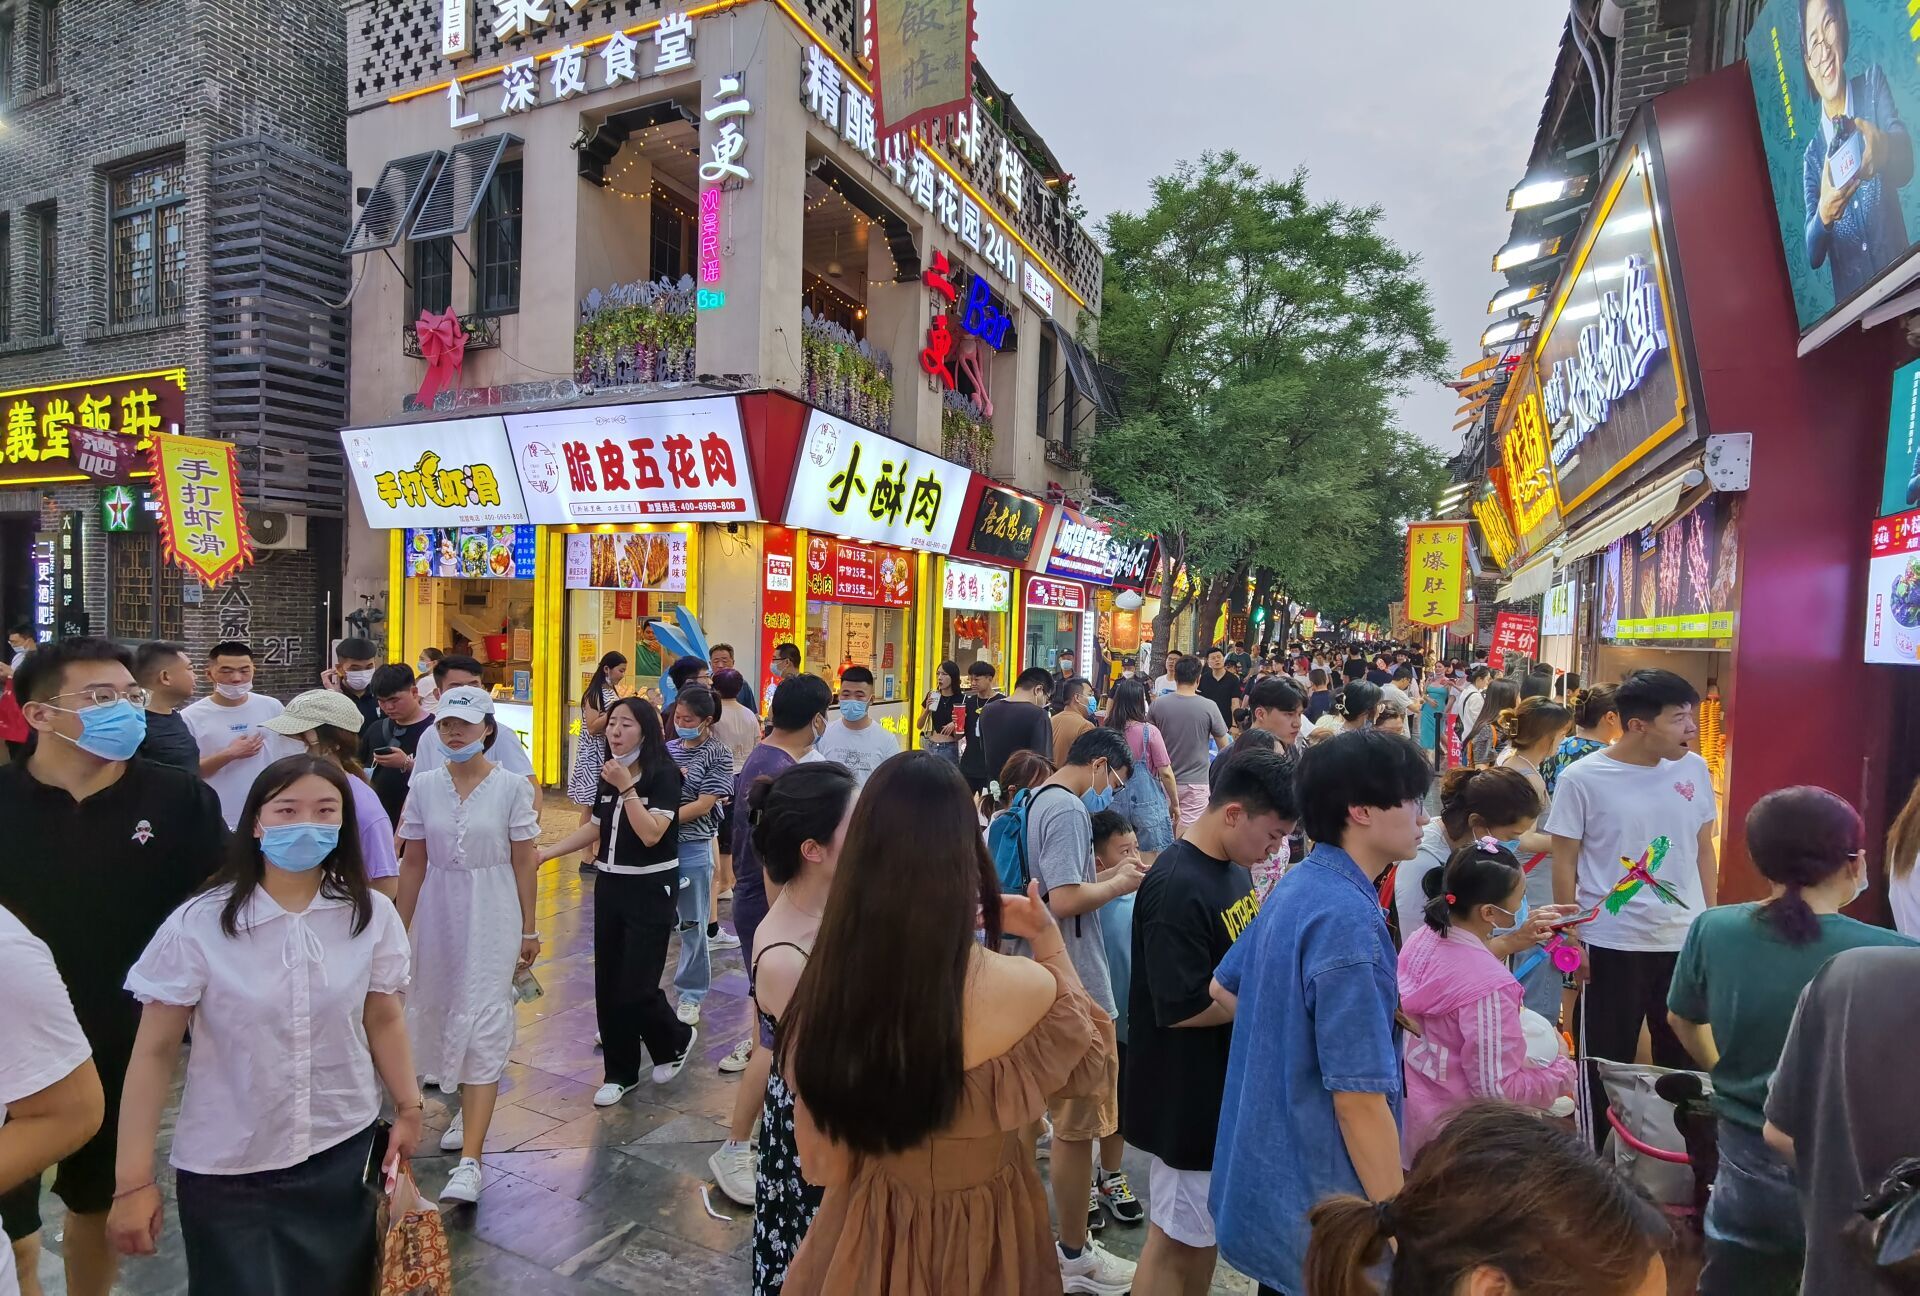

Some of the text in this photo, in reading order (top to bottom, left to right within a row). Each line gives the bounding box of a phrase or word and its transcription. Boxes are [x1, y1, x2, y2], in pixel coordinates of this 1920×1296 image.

[501, 12, 696, 115] 深夜食堂
[700, 77, 752, 182] 二更
[701, 189, 721, 282] 观景民谣
[960, 273, 1011, 351] Bar
[0, 388, 161, 463] 義堂飯莊
[561, 432, 738, 493] 脆皮五花肉
[176, 458, 226, 556] 手打虾滑
[826, 440, 943, 534] 小酥肉
[38, 541, 51, 626] 二更酒吧
[1422, 551, 1449, 618] 爆肚王
[262, 636, 303, 666] 2F
[1498, 630, 1536, 650] 半价
[1501, 621, 1538, 632] 全场第二个
